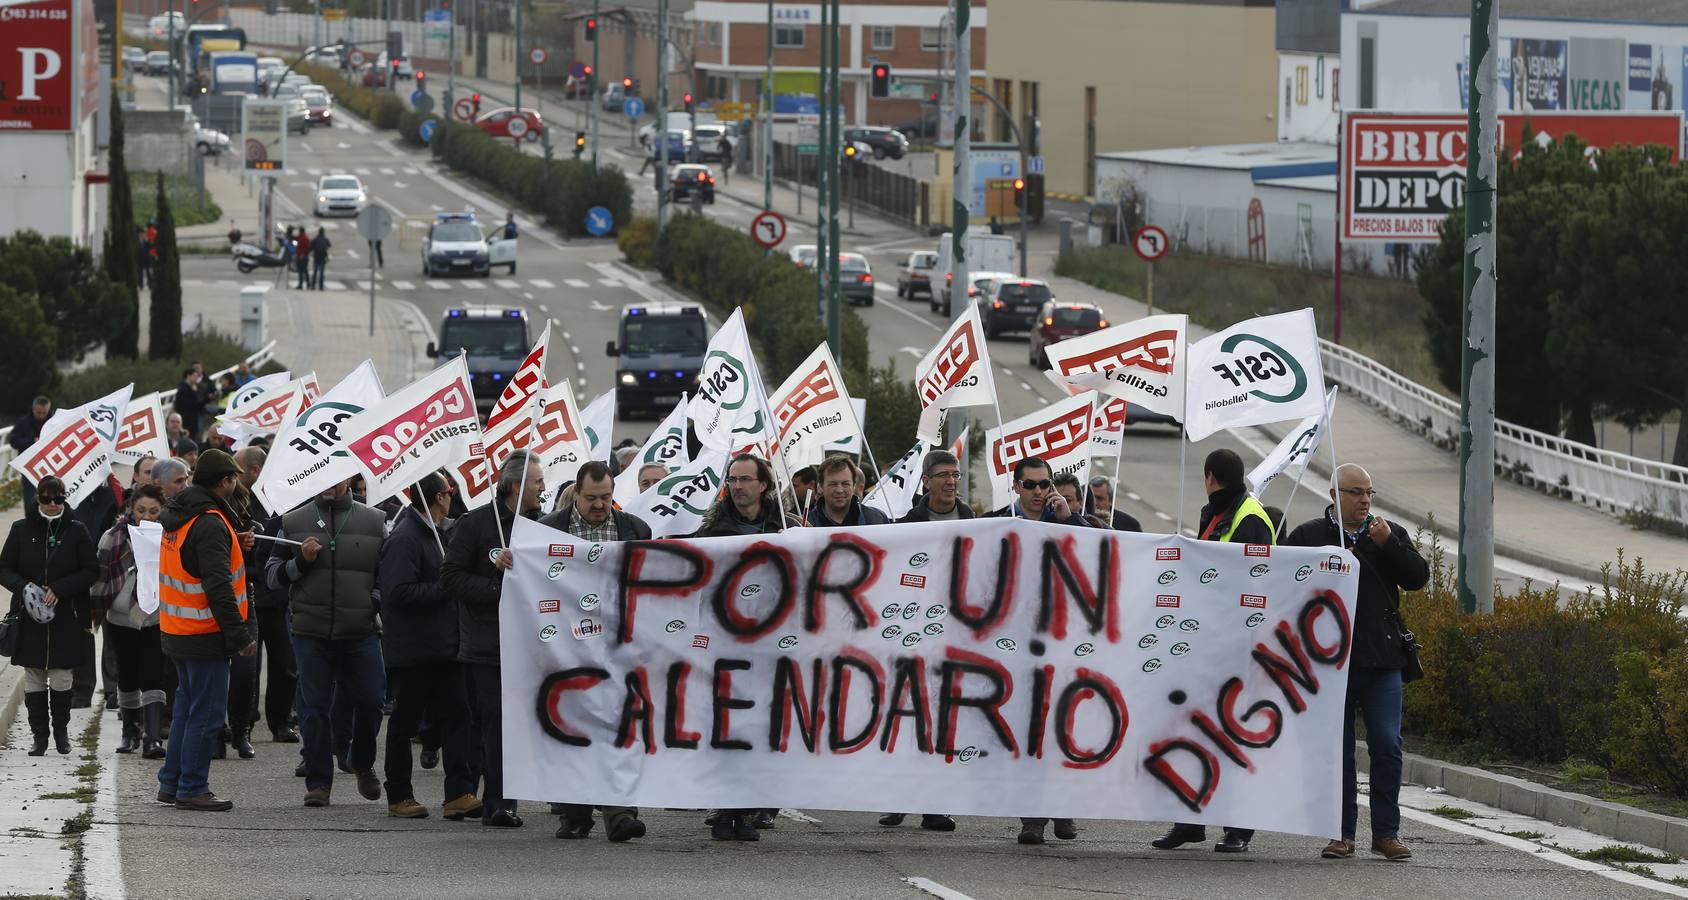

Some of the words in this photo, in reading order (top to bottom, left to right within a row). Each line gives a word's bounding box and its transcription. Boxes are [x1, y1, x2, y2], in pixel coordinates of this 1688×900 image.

[28, 9, 46, 19] 314
[16, 47, 62, 101] P
[1359, 130, 1467, 163] BRIC
[1353, 218, 1392, 232] PRECIOS
[1394, 219, 1424, 233] BAJOS
[616, 532, 888, 643] POR
[949, 531, 1121, 644] UN
